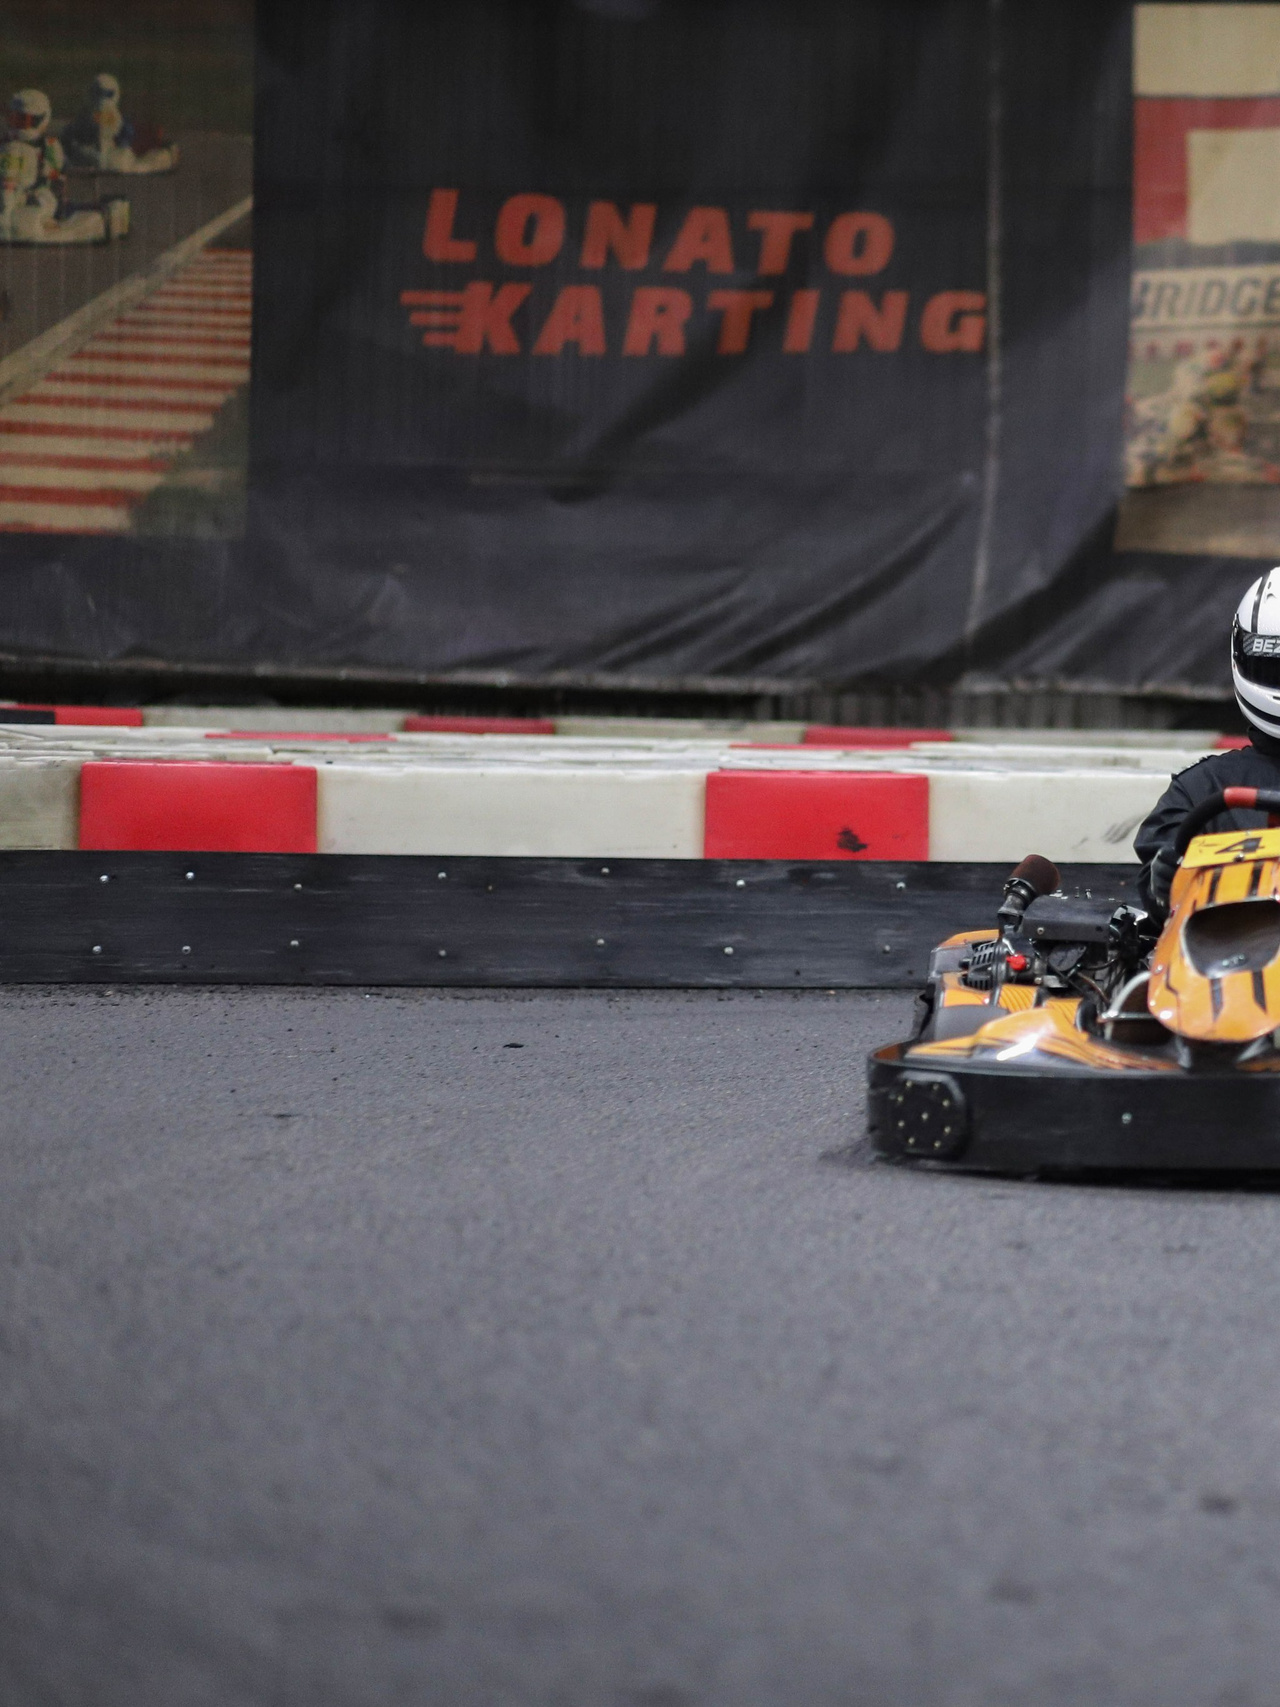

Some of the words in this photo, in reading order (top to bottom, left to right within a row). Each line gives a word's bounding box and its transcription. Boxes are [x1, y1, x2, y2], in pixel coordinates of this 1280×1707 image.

[422, 188, 895, 276] LONATO
[450, 280, 988, 355] KARTING
[1214, 836, 1263, 855] 4
